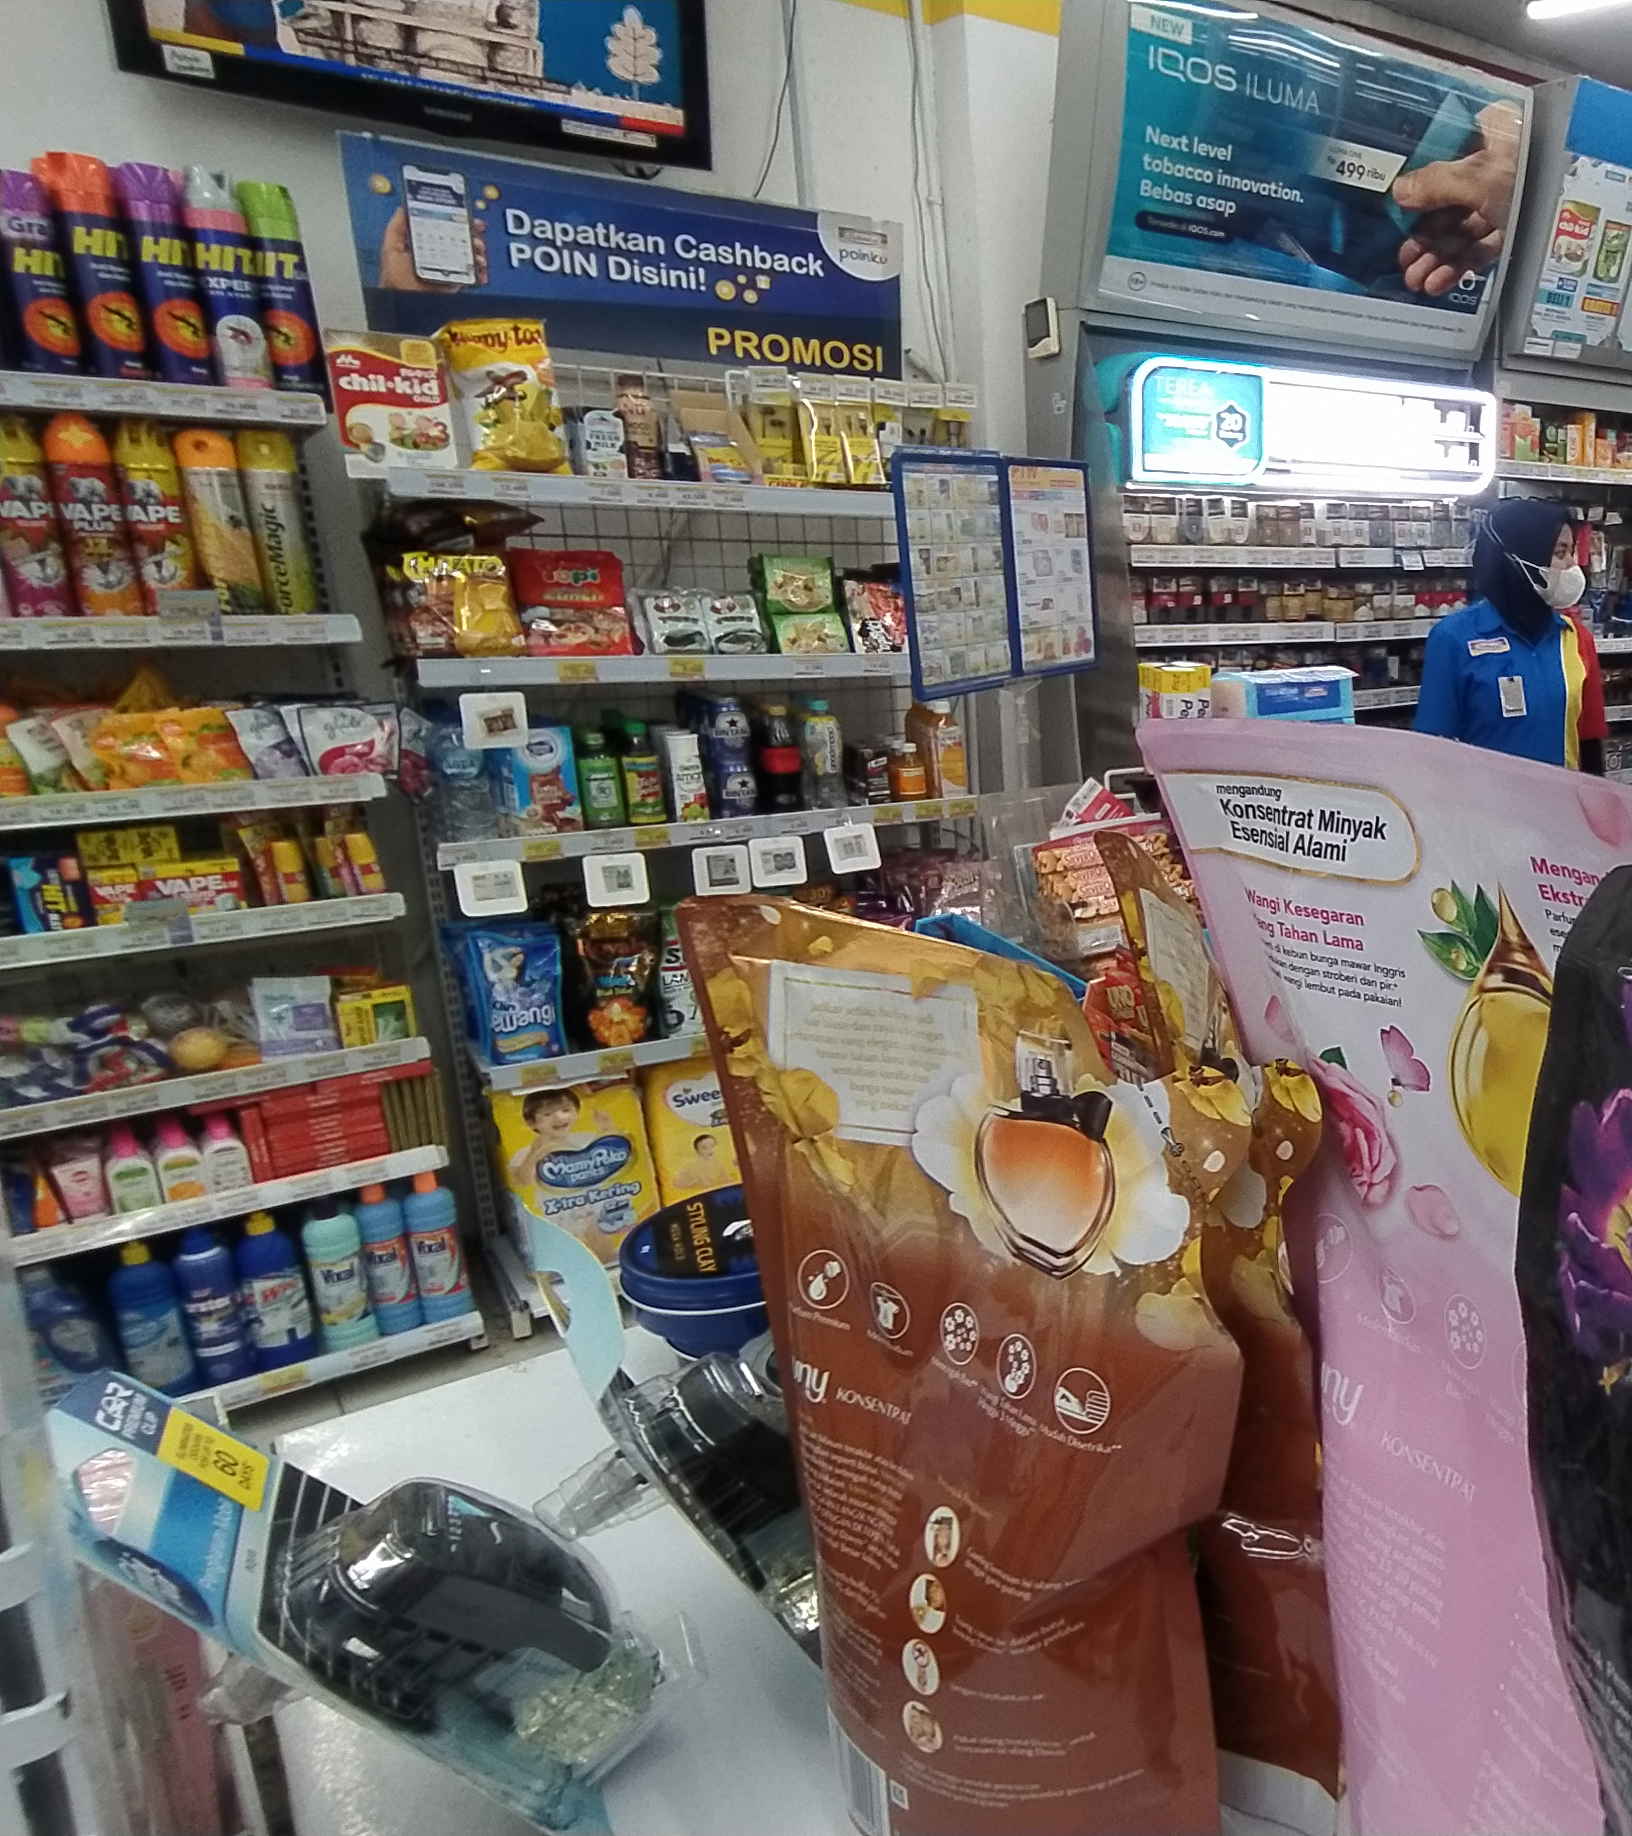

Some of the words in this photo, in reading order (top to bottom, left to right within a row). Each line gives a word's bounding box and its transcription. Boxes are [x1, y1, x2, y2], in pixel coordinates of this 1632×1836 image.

[1149, 14, 1186, 37] NEW
[1148, 45, 1237, 92] IQOS
[1245, 72, 1320, 116] ILUMA
[1145, 126, 1189, 153] Next
[1192, 135, 1233, 163] level
[1143, 153, 1214, 185] tobacco
[1216, 168, 1304, 205] innovation.
[1335, 160, 1366, 180] 499
[1367, 167, 1386, 181] ribu
[1140, 179, 1194, 207] Bebas
[1196, 194, 1238, 218] asap
[141, 235, 190, 265] HI
[195, 242, 256, 275] HIT
[505, 207, 665, 257] Dapatkan
[673, 235, 826, 279] Cashback
[839, 246, 888, 267] poinku
[510, 242, 599, 278] POIN
[608, 253, 707, 291] Disini!
[706, 326, 885, 373] PROMOSI
[1220, 411, 1243, 432] 20
[60, 503, 122, 521] VAPE
[127, 503, 183, 524] APE
[1216, 784, 1282, 801] mengandung
[1218, 798, 1314, 830] Konsentrat
[1317, 809, 1387, 843] Minyak
[1230, 820, 1290, 853] Esensial
[1292, 834, 1348, 862] Alami
[155, 876, 224, 894] VAPE
[1529, 856, 1602, 887] Mengan
[1244, 887, 1281, 915] Wangi
[1283, 899, 1365, 927] Kesegaran
[1538, 883, 1588, 908] Ekstr
[1277, 920, 1319, 944] Tahan
[1323, 930, 1364, 952] Lama
[1282, 944, 1308, 961] kebun
[1309, 951, 1339, 967] bunga
[1340, 959, 1372, 972] mawar
[1373, 962, 1406, 980] Inggris
[1288, 961, 1320, 978] dengan
[1322, 969, 1358, 985] stroberi
[1359, 976, 1378, 989] dan
[1304, 979, 1336, 996] lembut
[1338, 985, 1362, 1001] pada
[1363, 992, 1403, 1008] pakaian!
[671, 1086, 722, 1109] Swee
[541, 1144, 630, 1180] MamyPoko
[587, 1179, 643, 1206] Kering
[686, 1201, 712, 1248] STYLING
[95, 1381, 135, 1433] CAR
[836, 1387, 912, 1426] KONSENTRAT
[1322, 1361, 1365, 1427] ny
[213, 1449, 239, 1478] 60
[1380, 1430, 1478, 1502] KONSENTRAT
